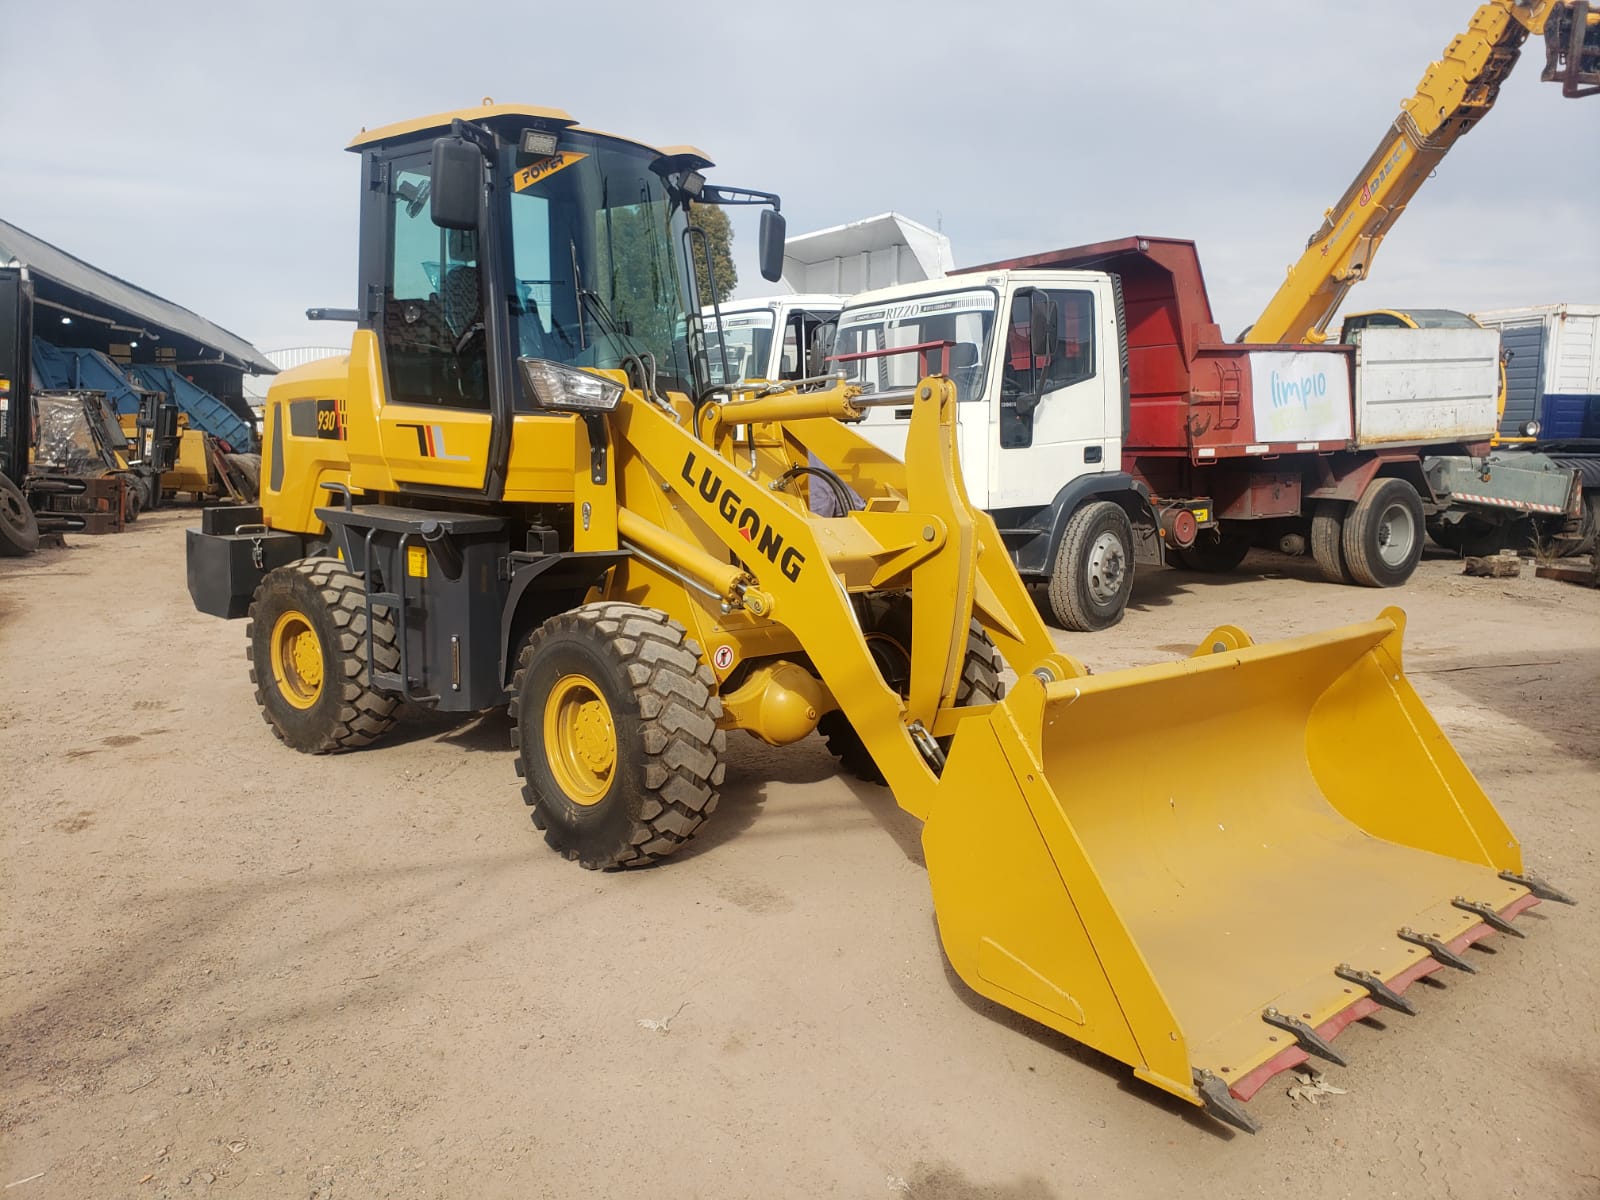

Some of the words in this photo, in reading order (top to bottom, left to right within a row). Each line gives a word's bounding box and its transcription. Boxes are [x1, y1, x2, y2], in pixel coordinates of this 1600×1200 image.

[522, 154, 565, 184] POWER
[885, 304, 920, 320] RIZZO
[1270, 369, 1327, 411] limpio
[318, 410, 336, 431] 930
[681, 451, 807, 583] LUGONG
